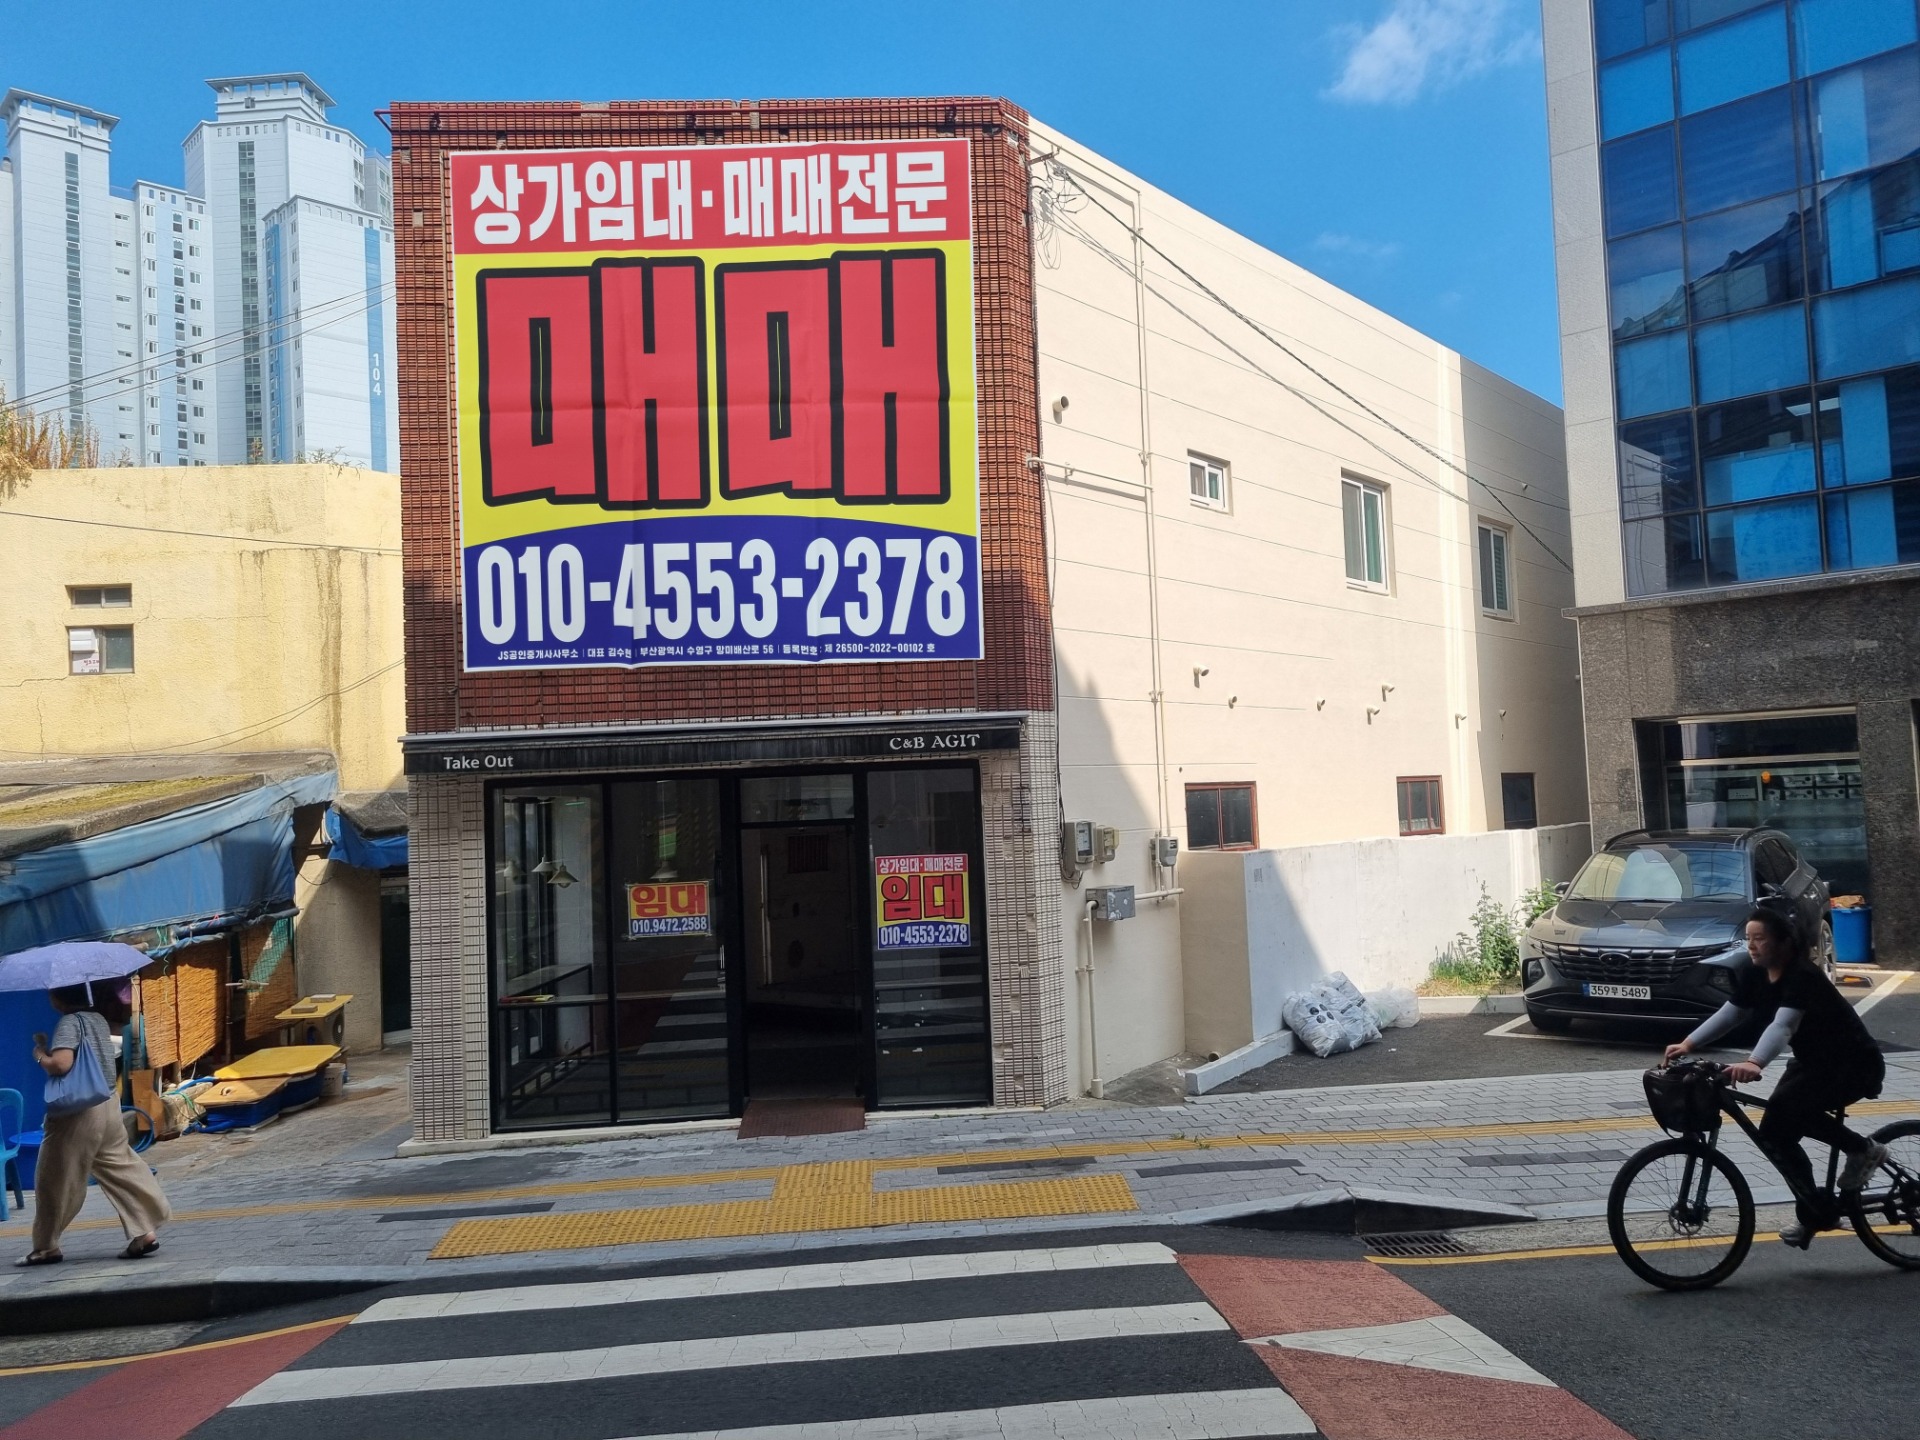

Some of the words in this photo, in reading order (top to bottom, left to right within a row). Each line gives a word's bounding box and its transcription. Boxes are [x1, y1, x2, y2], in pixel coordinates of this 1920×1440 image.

[470, 150, 947, 245] 상가임대·매매전문
[372, 353, 382, 396] 104
[476, 248, 951, 511] 매매
[477, 536, 965, 645] 010-4553-2378
[498, 649, 579, 660] JS공인중개사사무소
[588, 648, 604, 658] 대표
[640, 646, 684, 657] 부산광역시
[687, 645, 713, 656] 수영구
[716, 644, 760, 656] 망미배산로
[763, 644, 774, 655] 56
[824, 643, 833, 653] 제
[836, 643, 924, 653] 26500-2022-00102
[926, 643, 936, 653] 호
[889, 736, 925, 750] C&B
[931, 733, 980, 748] AGIT
[443, 755, 480, 770] Take
[484, 754, 514, 768] Out
[880, 856, 964, 873] 상가임대·매매전문
[631, 884, 707, 917] 임대
[881, 873, 965, 921] 임대
[632, 917, 707, 933] 010.9472.2588
[880, 924, 968, 945] 010-4553-2378
[1621, 986, 1648, 998] 5489
